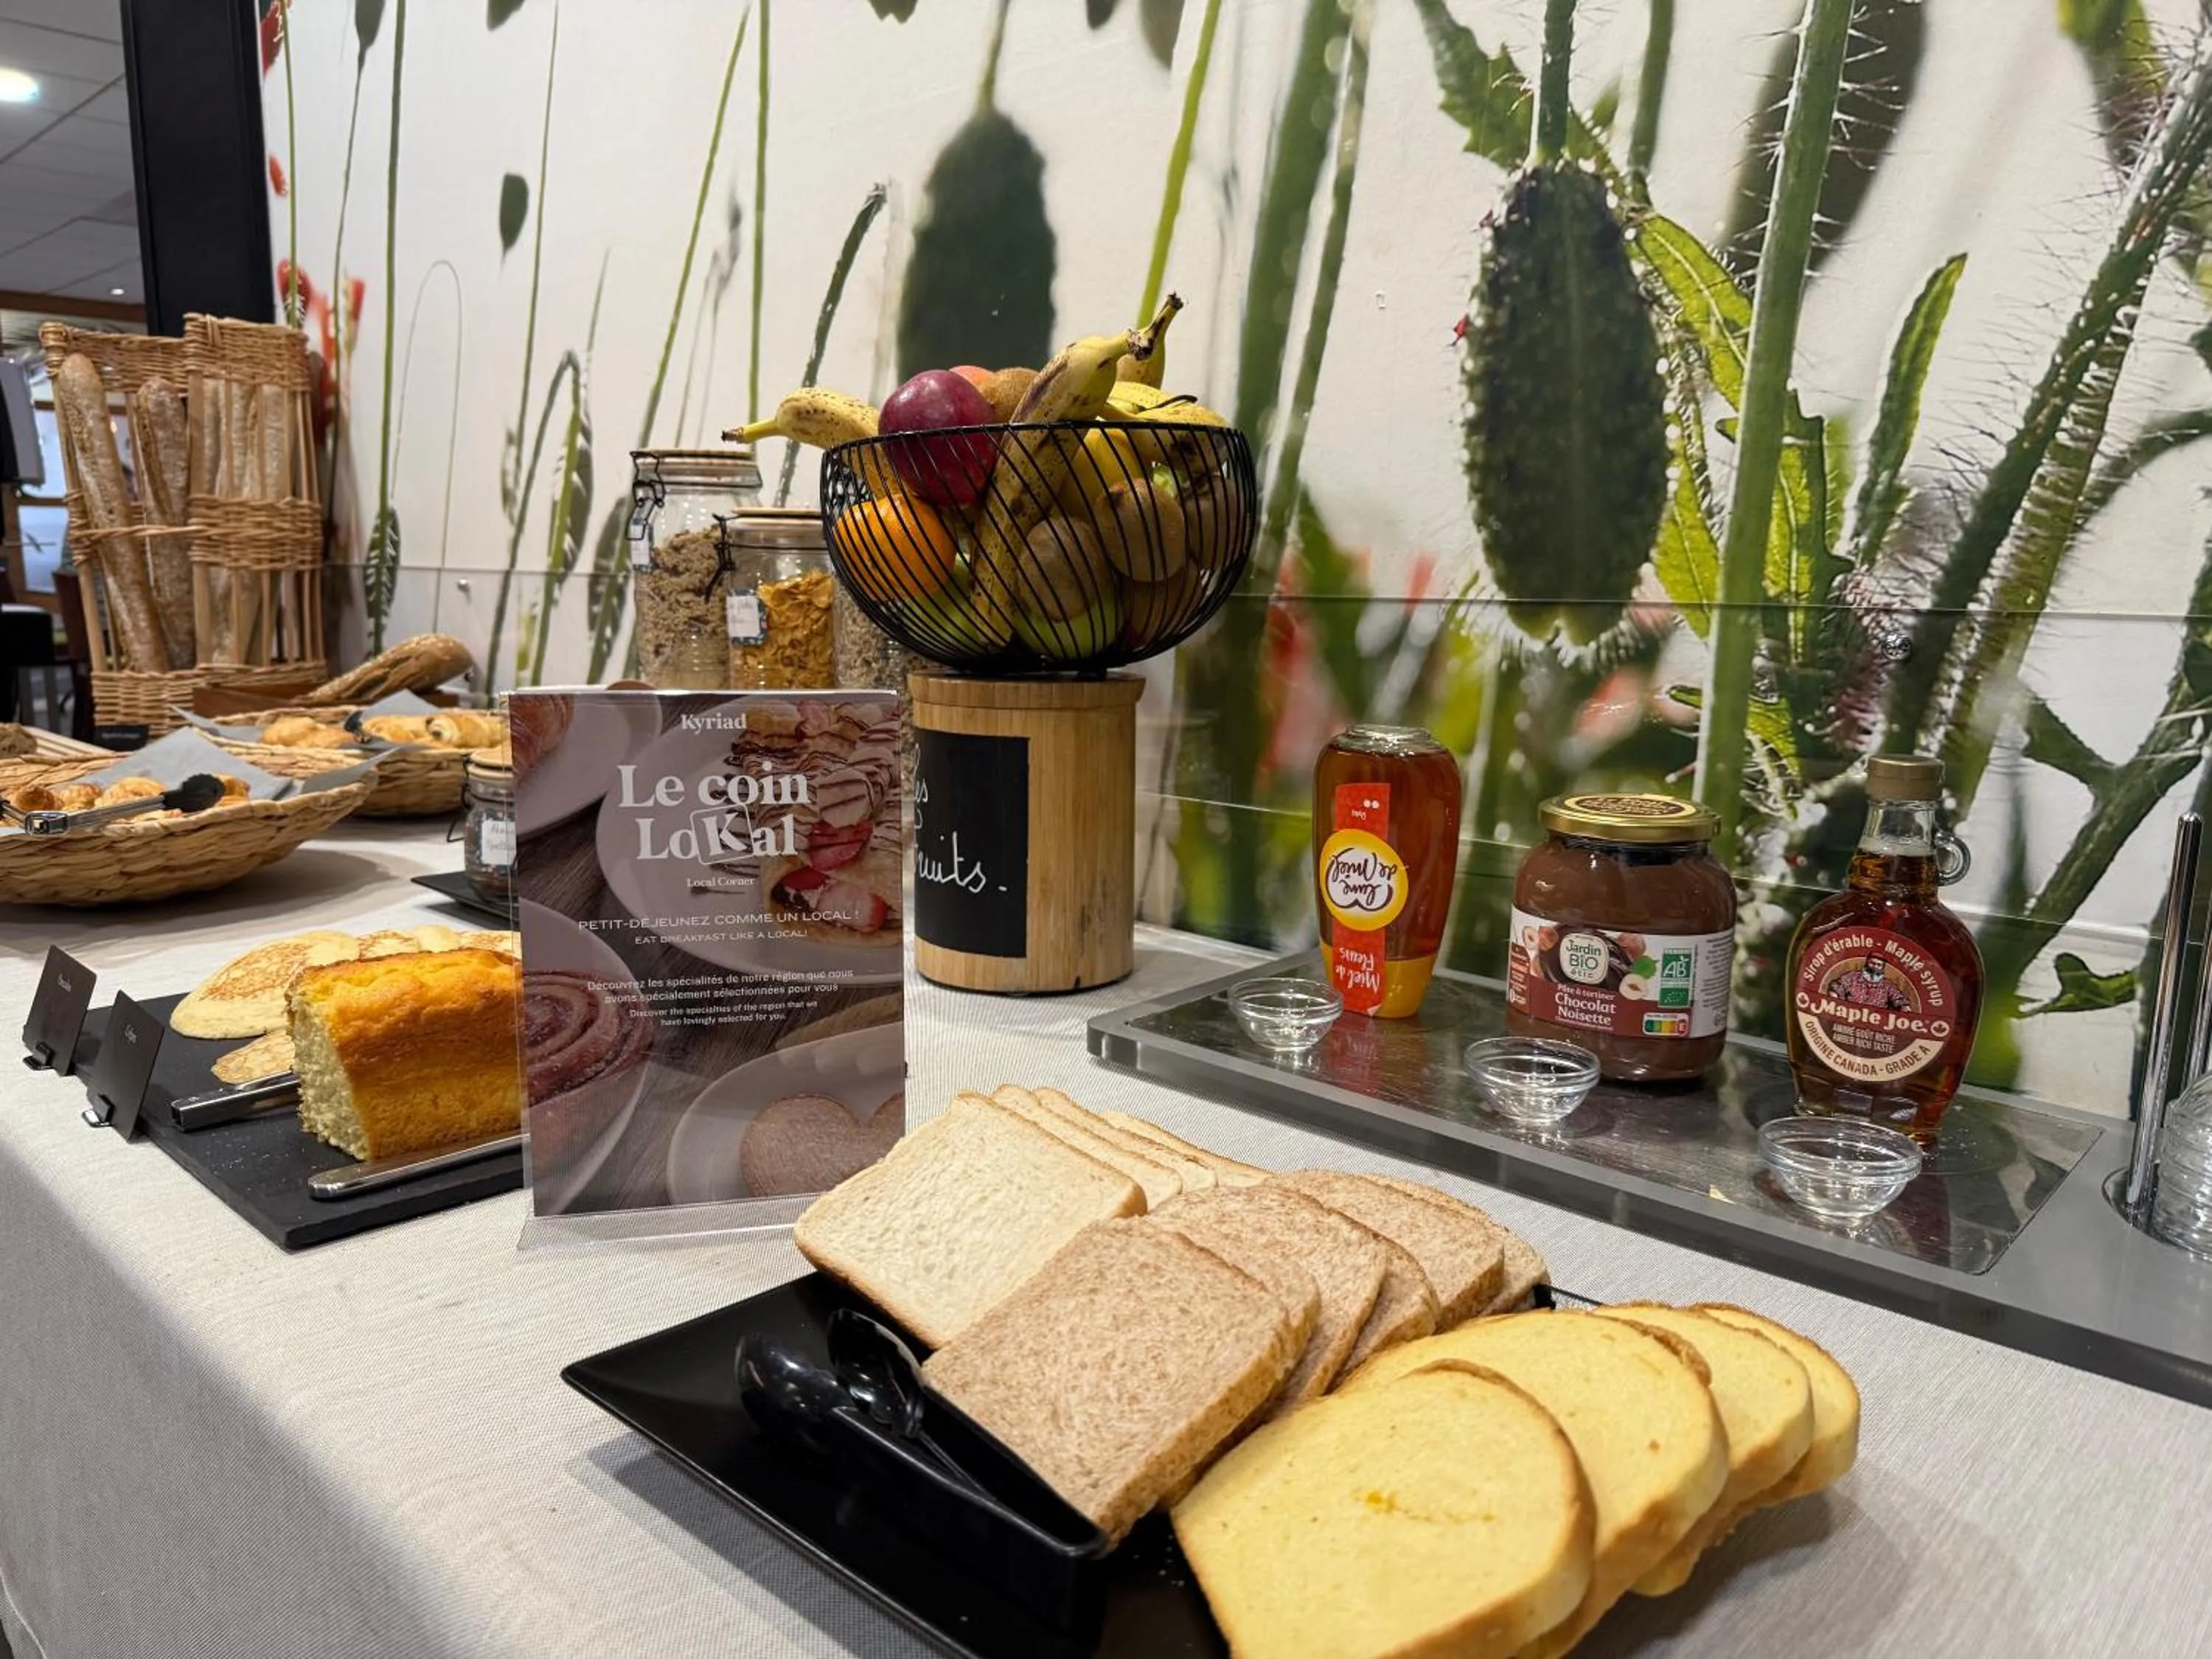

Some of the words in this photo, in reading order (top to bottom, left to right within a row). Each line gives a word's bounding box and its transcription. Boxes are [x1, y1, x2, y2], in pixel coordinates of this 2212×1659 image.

[681, 713, 747, 734] Kyriad
[617, 765, 686, 807] Le
[698, 760, 811, 806] coin
[635, 812, 798, 859] LoKal
[686, 877, 716, 888] Local
[717, 876, 755, 886] Corner
[1379, 862, 1397, 881] de
[714, 914, 773, 925] COMME
[776, 912, 797, 922] UN
[802, 911, 852, 922] LOCAL
[635, 935, 656, 945] EAT
[661, 933, 726, 943] BREAKFAST
[730, 932, 754, 941] LIKE
[757, 931, 765, 939] A
[768, 929, 807, 939] LOCAL!
[1566, 939, 1601, 956] Jardin
[1339, 947, 1374, 970] Fleurs
[1804, 952, 1825, 981] Sirop
[1823, 934, 1874, 956] d'érable
[1885, 940, 1924, 970] Maple
[588, 980, 645, 991] Découvrez
[648, 978, 664, 987] les
[667, 975, 723, 988] spécialités
[726, 974, 739, 984] de
[741, 973, 768, 983] notre
[772, 970, 804, 983] région
[807, 971, 827, 981] que
[828, 970, 854, 979] nous
[1335, 964, 1346, 980] de
[1347, 969, 1380, 993] Miel
[605, 995, 637, 1004] avons
[640, 990, 710, 1004] spécialement
[713, 985, 785, 998] sélectionnées
[788, 985, 810, 995] pour
[814, 984, 839, 992] vous
[1555, 992, 1617, 1014] Chocolat
[630, 1009, 667, 1018] Discover
[670, 1007, 684, 1015] the
[744, 1004, 757, 1012] the
[759, 1002, 785, 1012] region
[1558, 1005, 1611, 1026] Noisette
[1810, 998, 1881, 1024] Maple
[1884, 1014, 1928, 1033] Joe
[1805, 1020, 1834, 1060] ORIGINE
[1834, 1054, 1878, 1076] CANADA
[1885, 1052, 1921, 1074] GRADE
[1921, 1044, 1932, 1055] A
